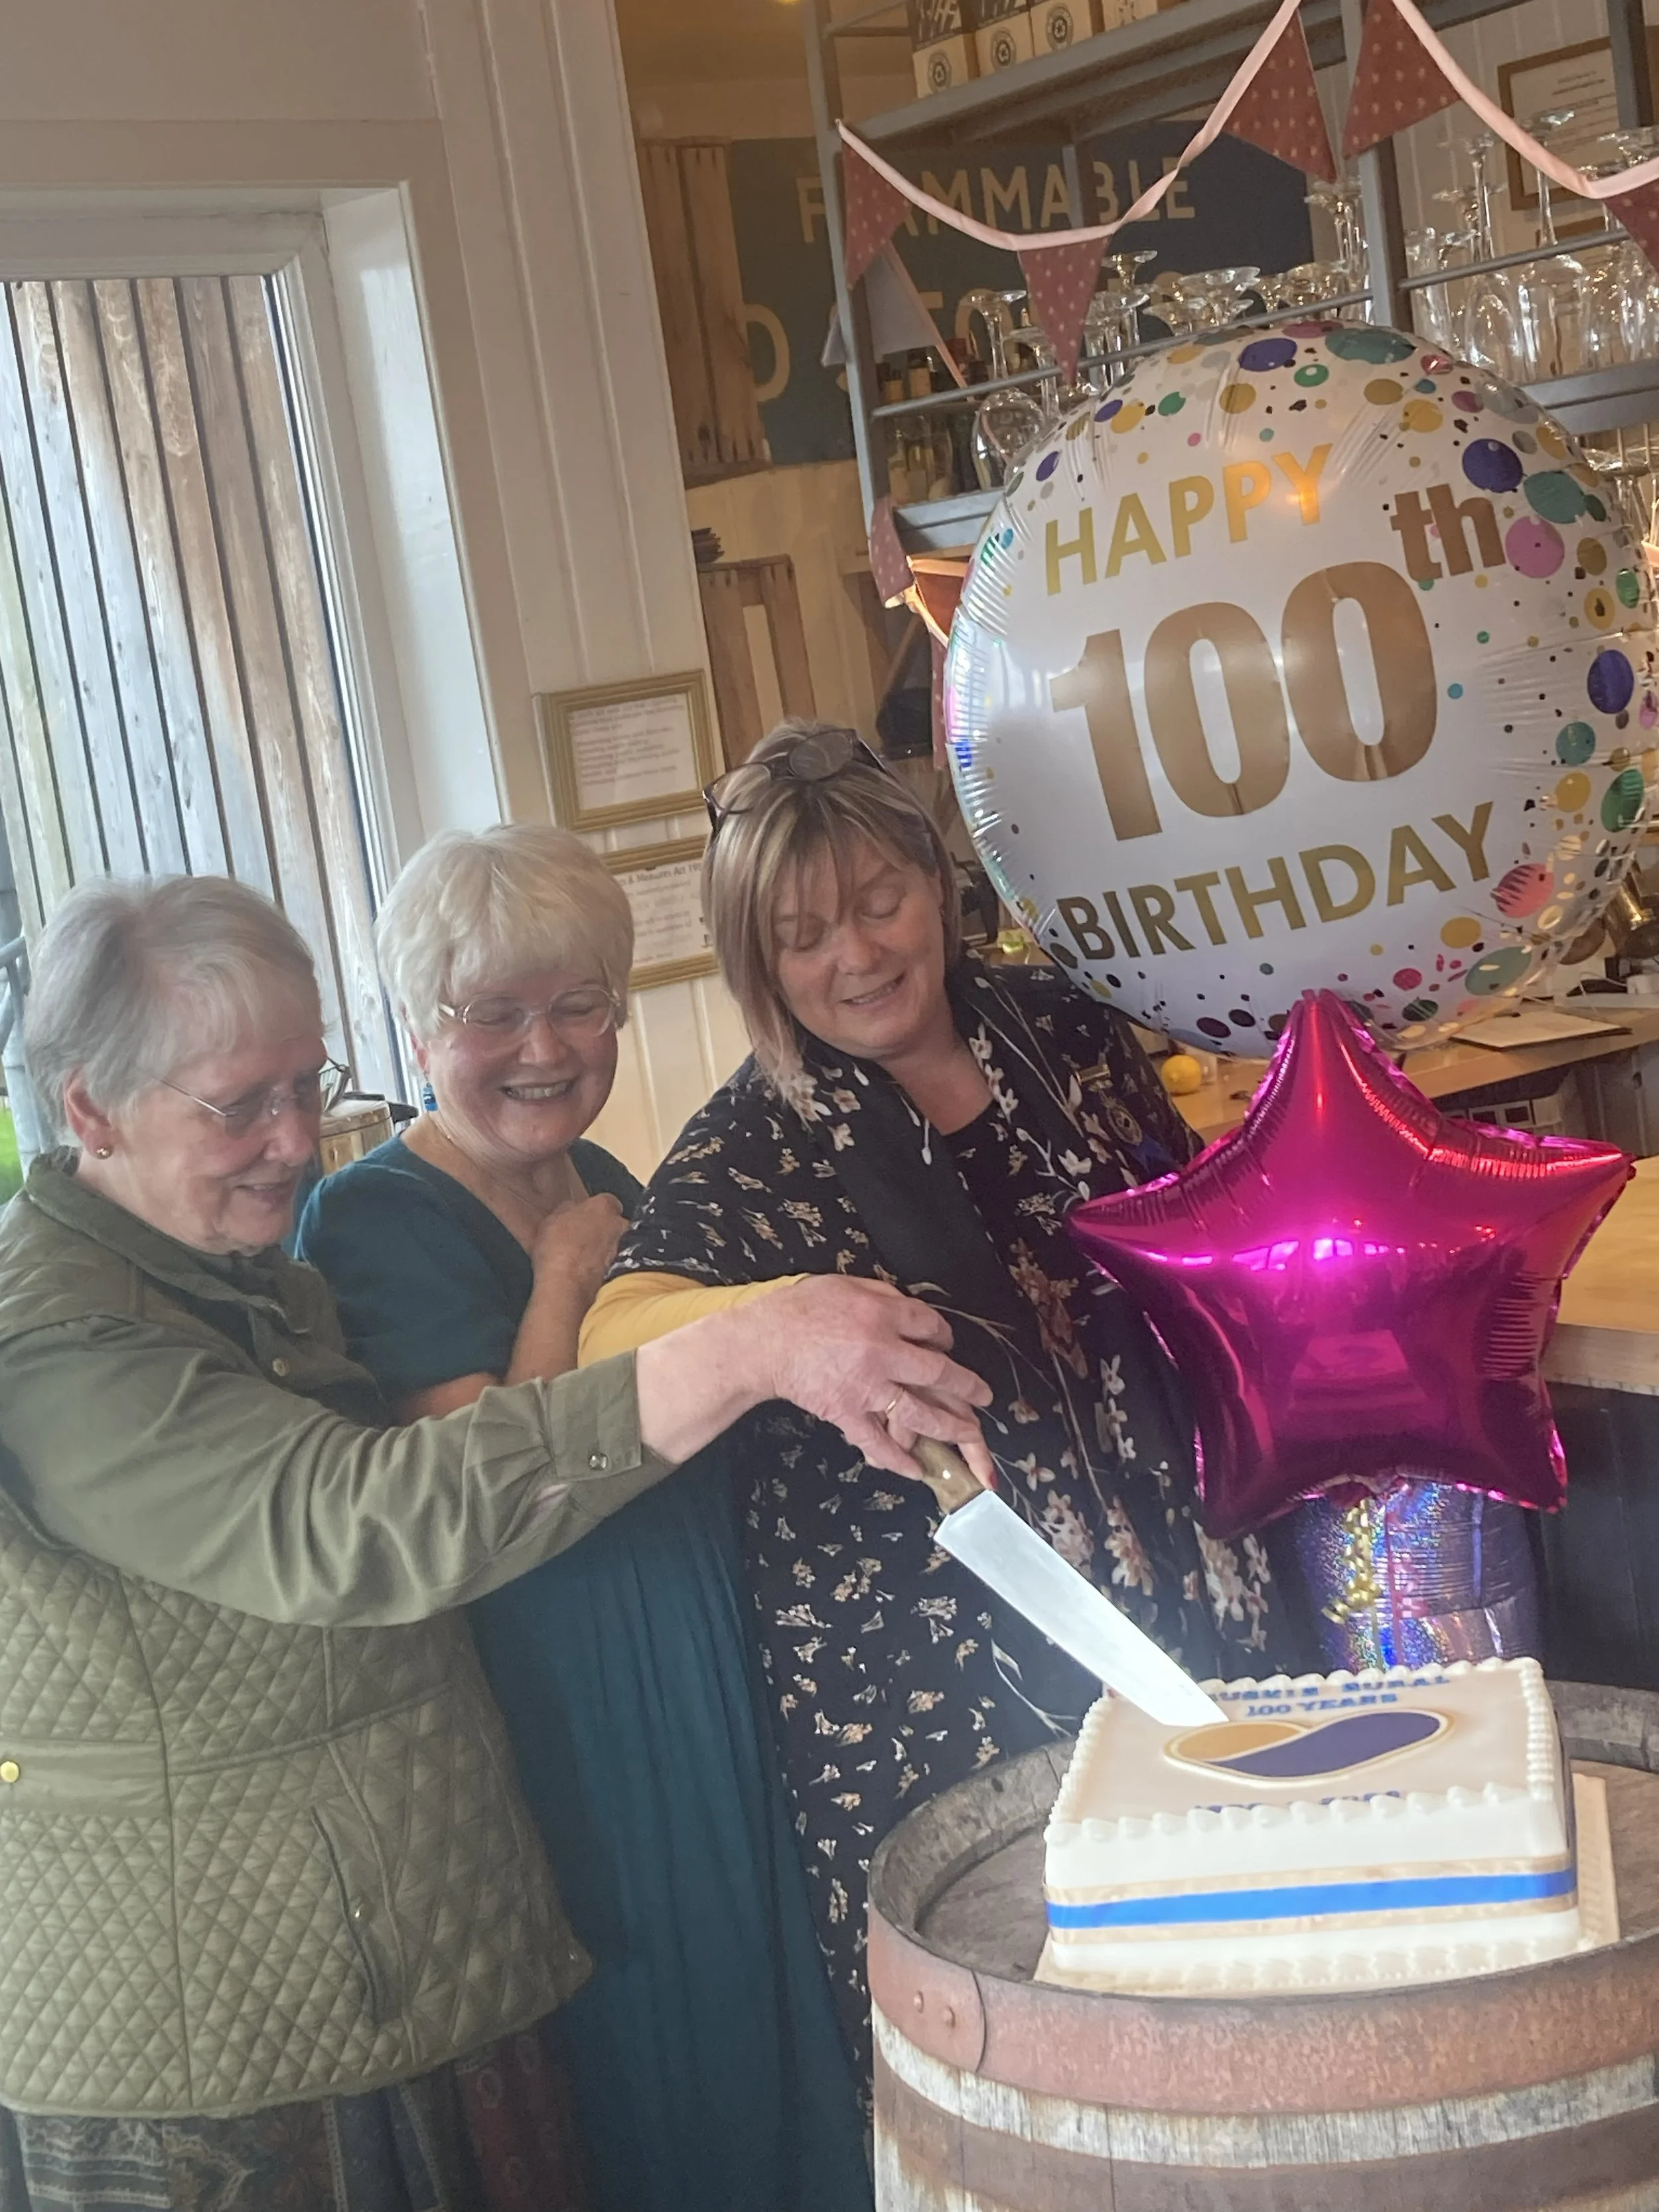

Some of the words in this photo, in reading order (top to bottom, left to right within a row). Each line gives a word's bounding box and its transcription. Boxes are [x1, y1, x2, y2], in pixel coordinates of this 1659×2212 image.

[796, 157, 1195, 244] FMMABLE
[1043, 443, 1333, 596] HAPPY
[1049, 561, 1438, 842] 100
[1390, 483, 1506, 581] th
[1056, 801, 1494, 960] BIRTHDAY
[1245, 1704, 1292, 1717] 100
[1296, 1693, 1398, 1712] YEARS
